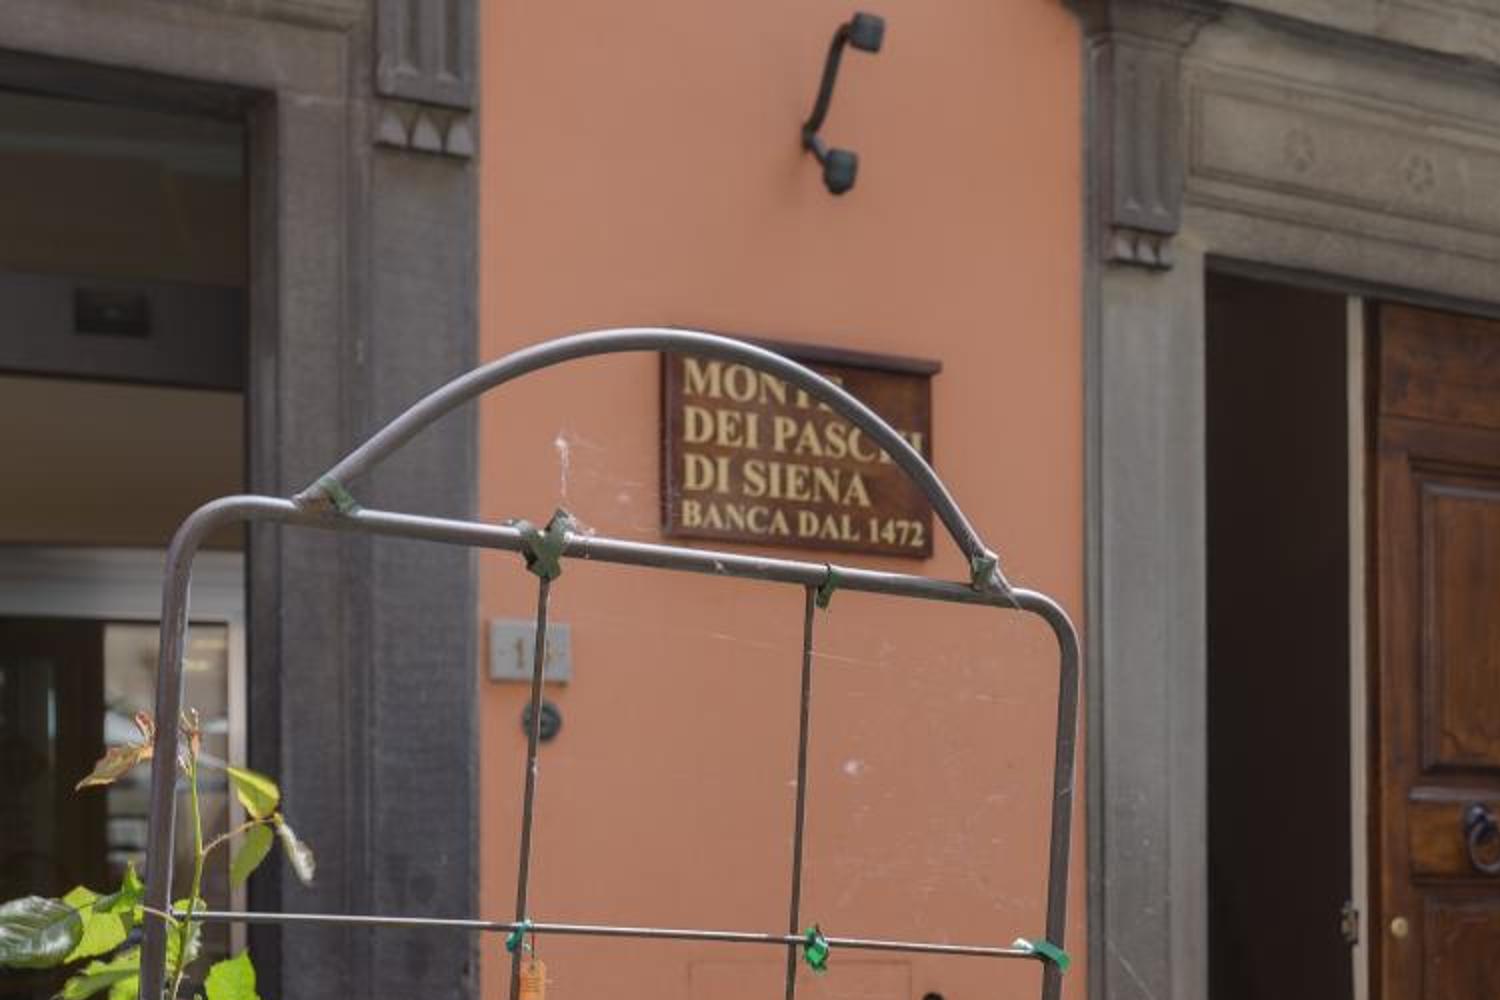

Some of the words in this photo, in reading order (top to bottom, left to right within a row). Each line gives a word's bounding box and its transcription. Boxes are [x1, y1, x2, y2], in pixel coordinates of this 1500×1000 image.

[683, 358, 843, 410] MON
[683, 406, 759, 449] DEI
[683, 453, 729, 493] DI
[743, 461, 870, 506] SIENA
[681, 500, 789, 536] BANCA
[799, 511, 860, 541] DAL
[868, 519, 924, 547] 1472
